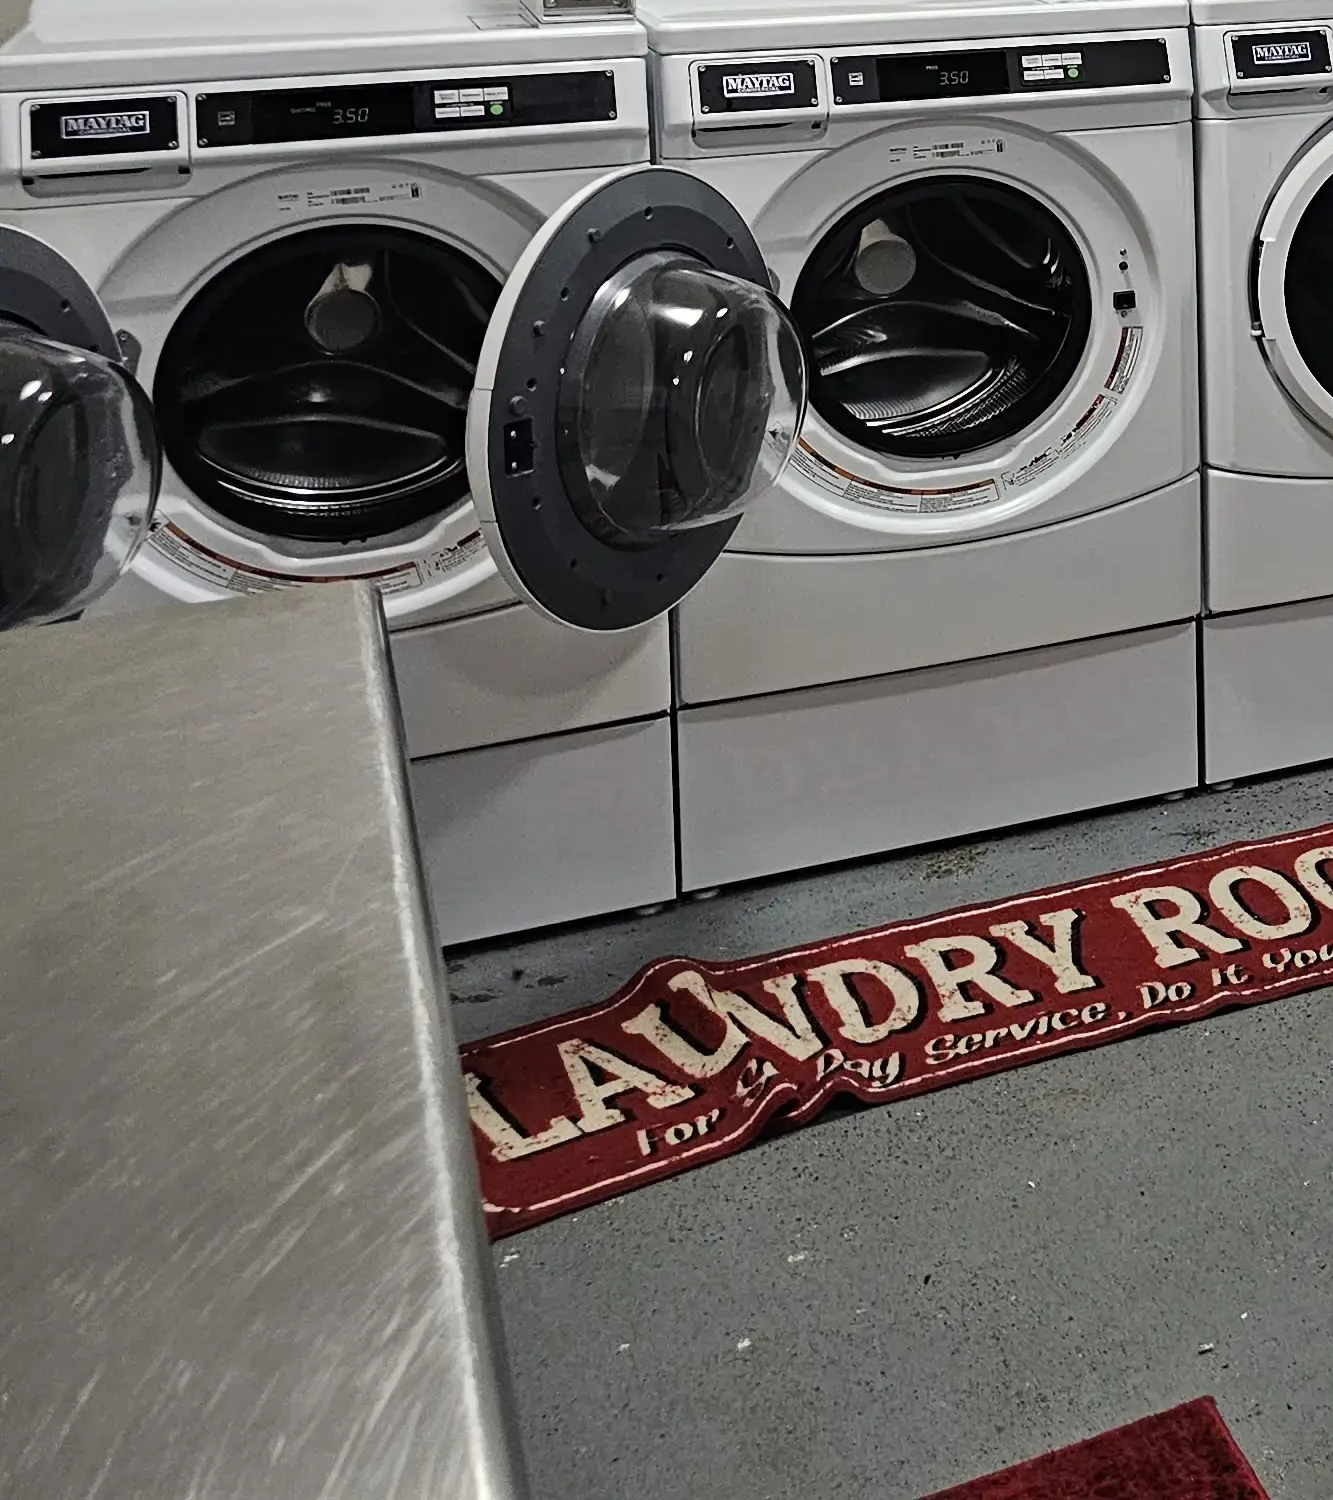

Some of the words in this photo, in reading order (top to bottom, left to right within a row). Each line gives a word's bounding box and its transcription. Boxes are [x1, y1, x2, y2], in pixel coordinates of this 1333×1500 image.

[1256, 44, 1307, 58] MAYTAG
[727, 75, 790, 90] MAYTAG
[939, 70, 969, 85] 3.50
[66, 114, 145, 131] MAYTAG
[332, 107, 369, 125] 3.50
[1139, 980, 1193, 1011] Do
[465, 908, 1096, 1163] LAUNDRY
